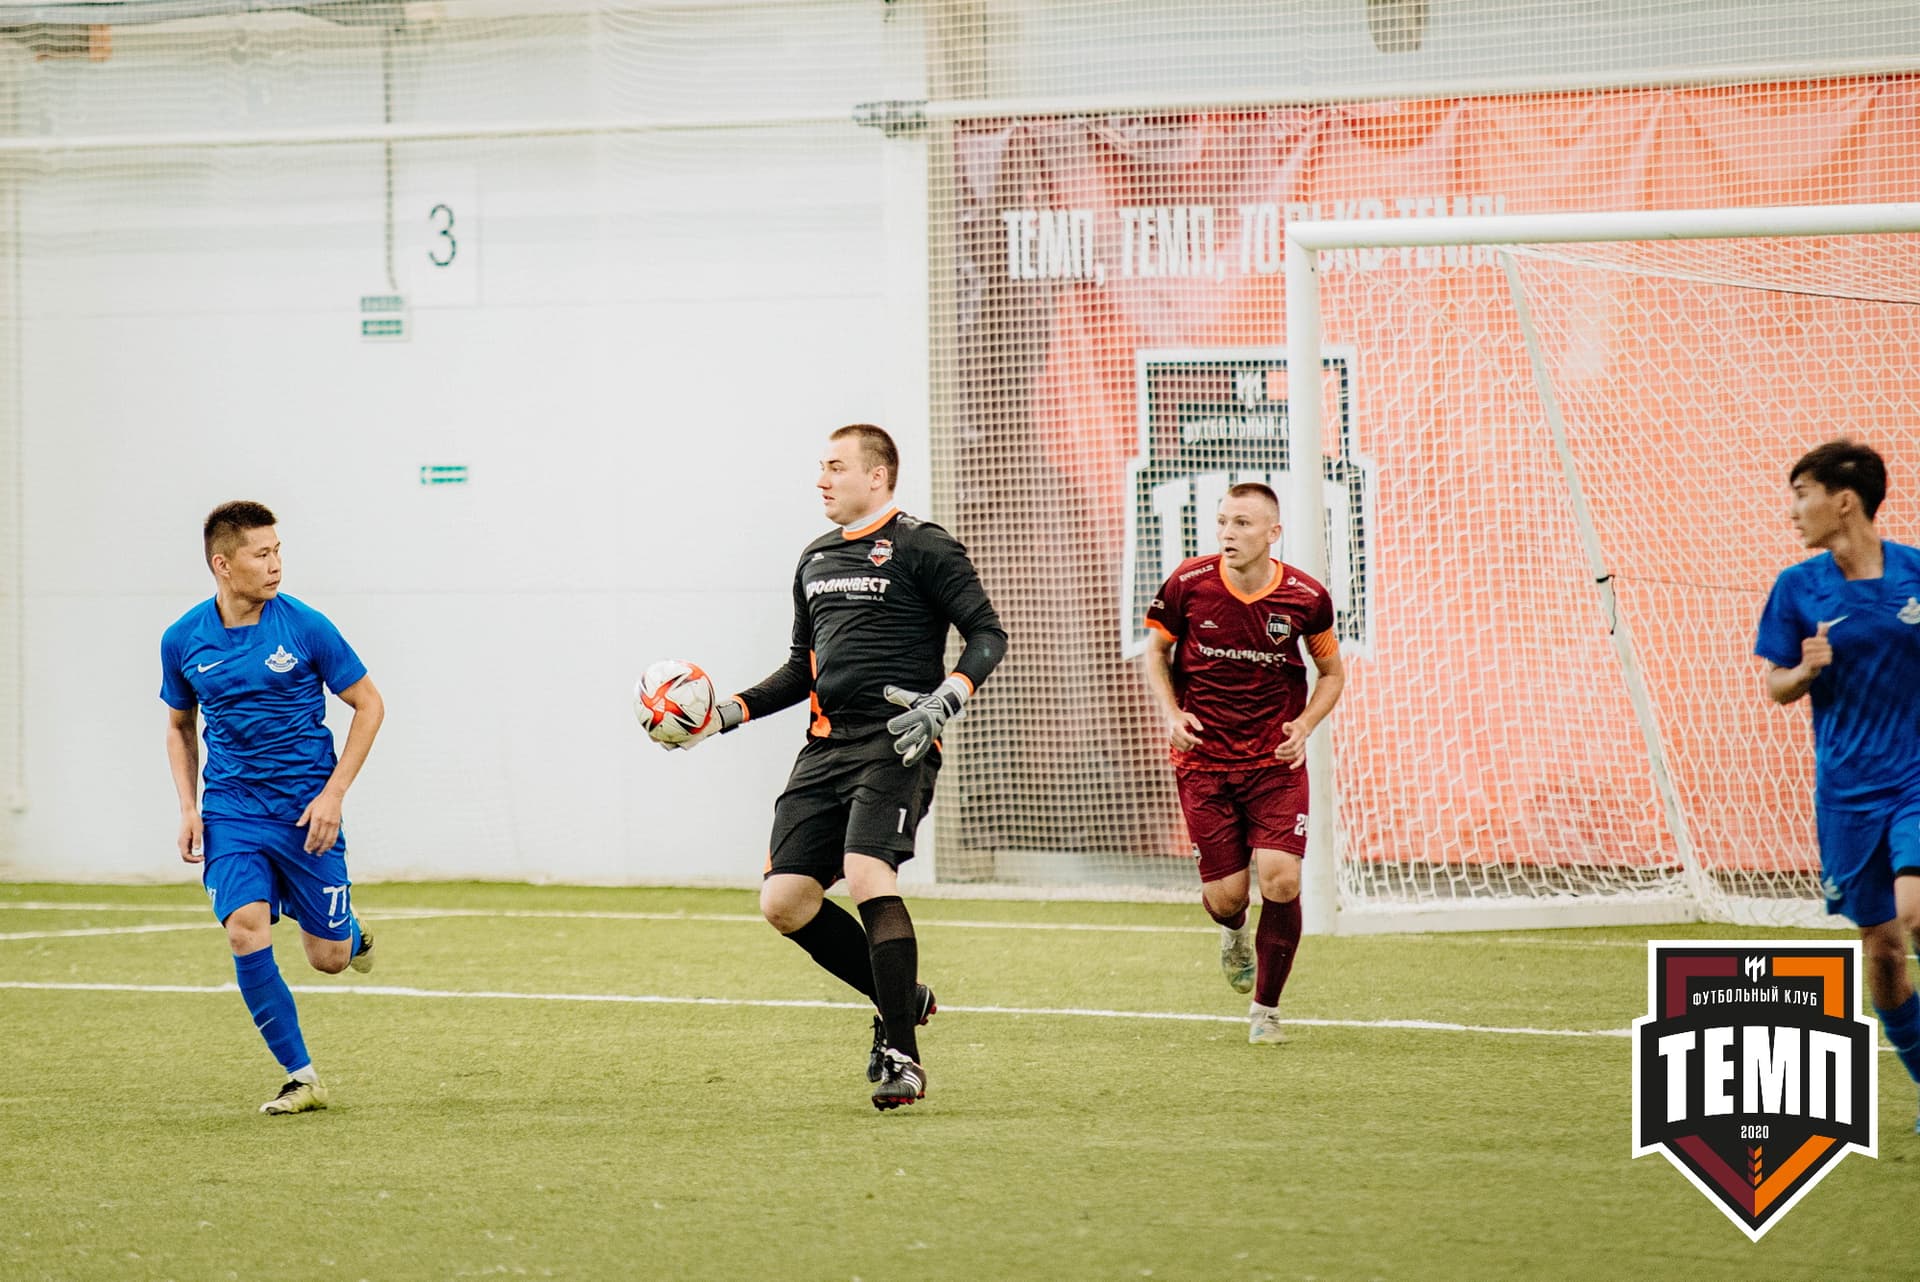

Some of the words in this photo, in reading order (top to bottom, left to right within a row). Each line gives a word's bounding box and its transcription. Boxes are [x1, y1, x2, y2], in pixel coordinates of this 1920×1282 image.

[429, 204, 456, 267] 3
[897, 808, 907, 833] 1
[322, 884, 347, 916] 77
